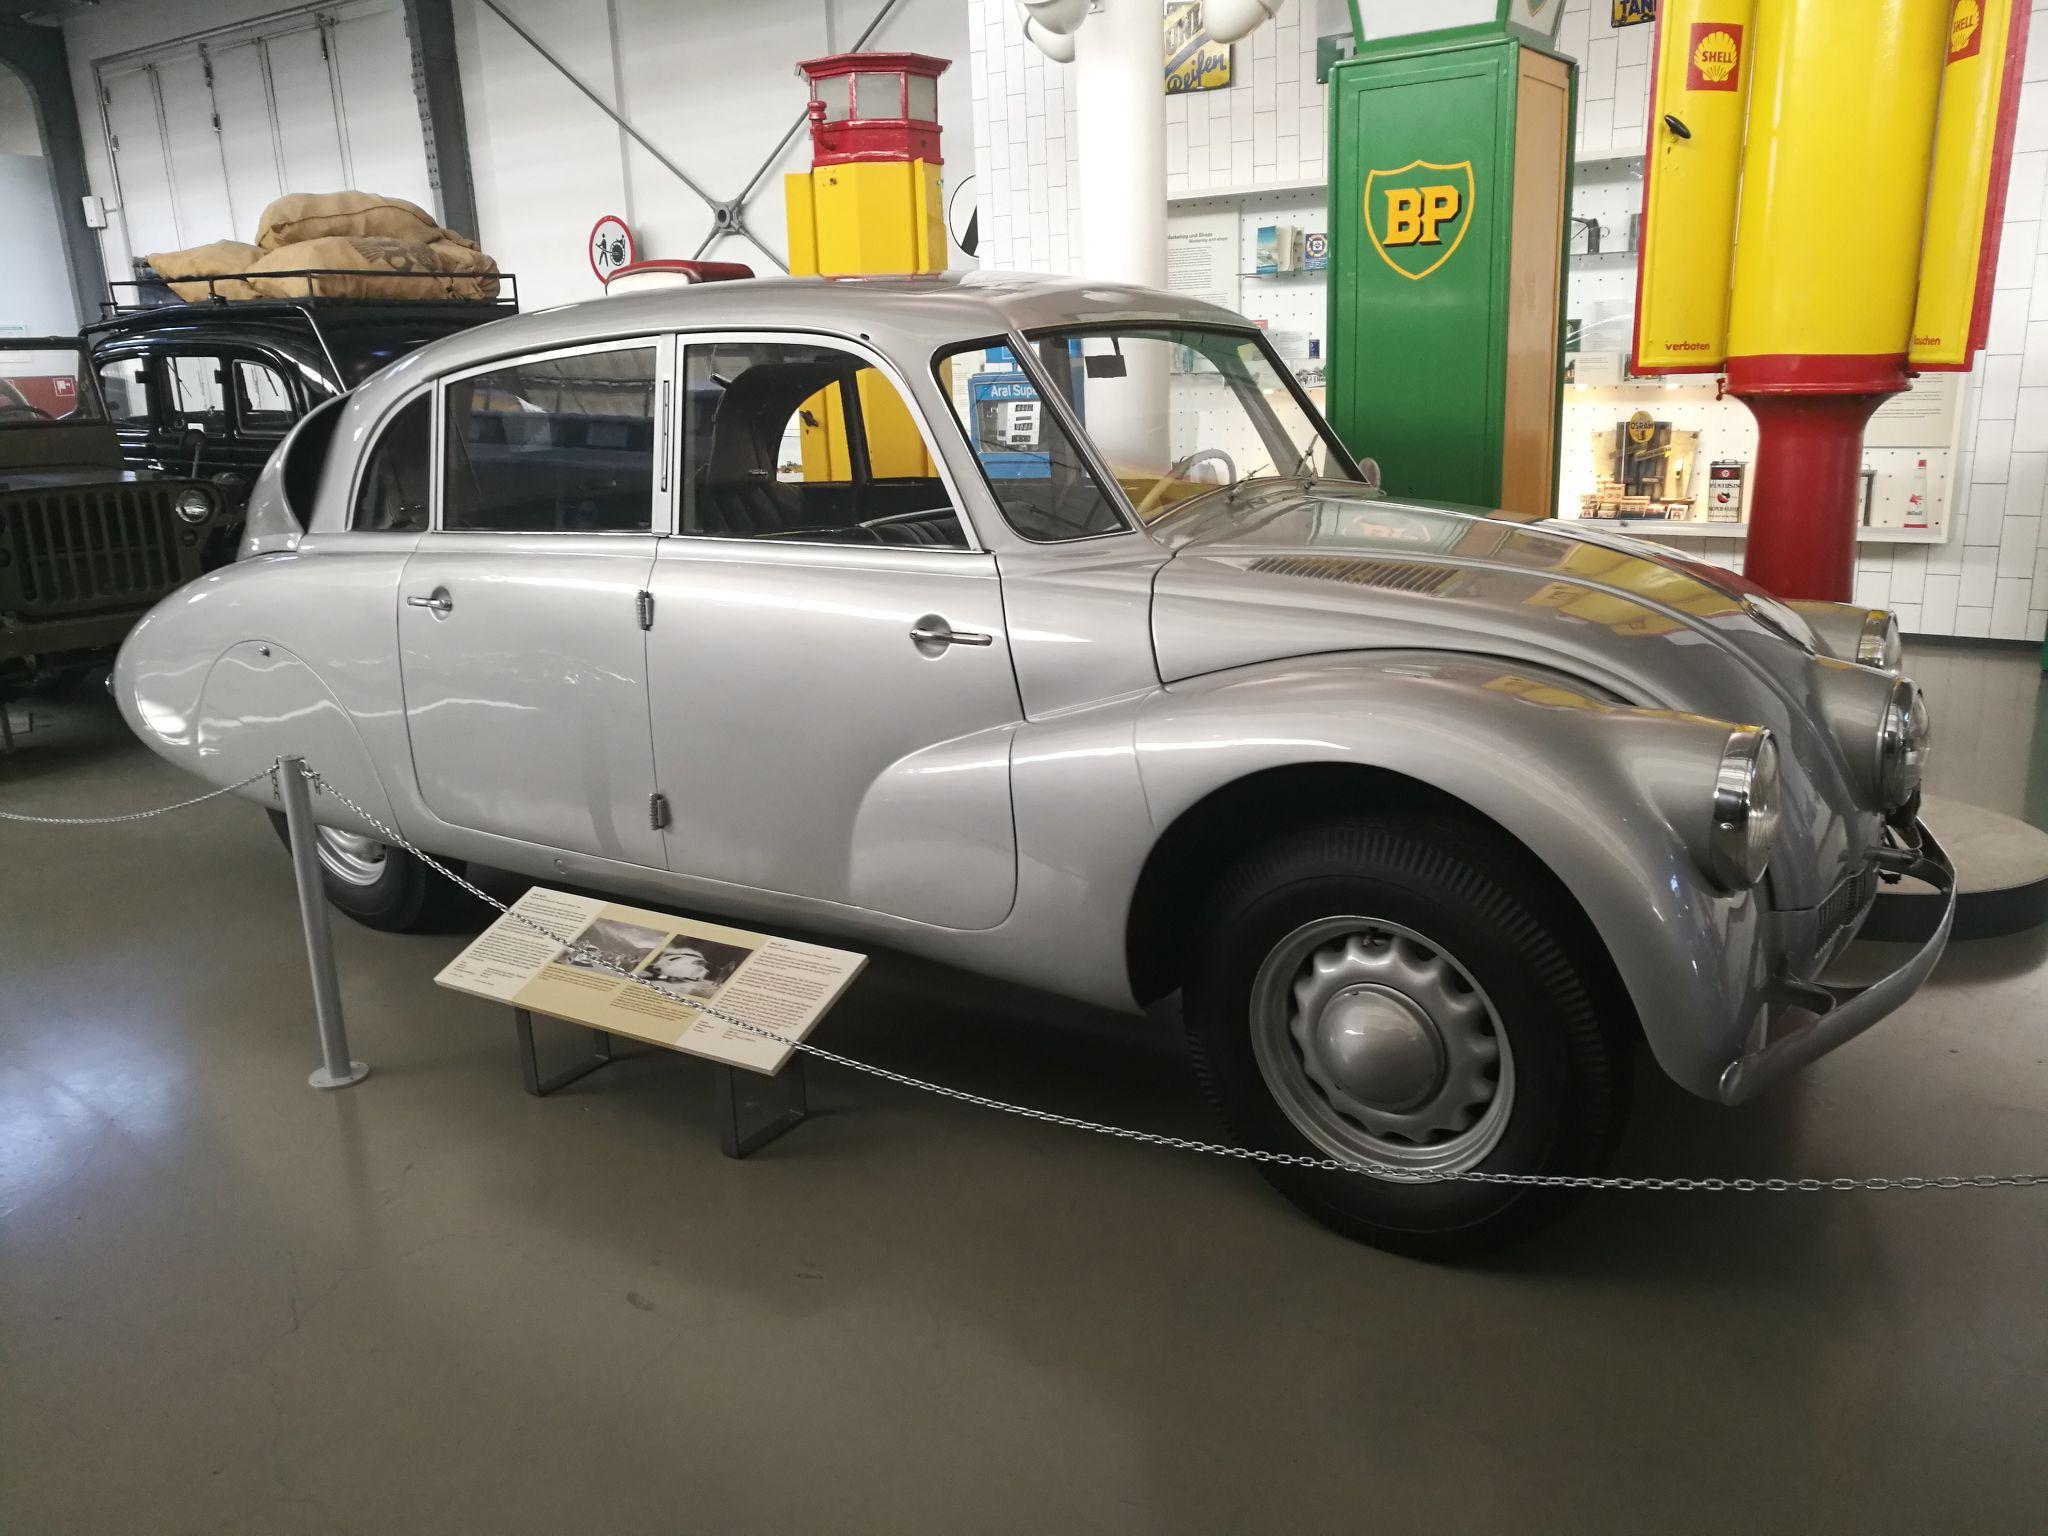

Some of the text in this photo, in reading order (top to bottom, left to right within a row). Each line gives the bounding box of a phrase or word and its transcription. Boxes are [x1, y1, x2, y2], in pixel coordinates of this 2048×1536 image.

[1953, 15, 1973, 33] SHELL
[1702, 51, 1732, 63] SHELL
[1167, 49, 1227, 92] Reifen
[1383, 185, 1462, 247] BP
[1665, 340, 1710, 351] verboten
[991, 385, 1011, 397] Aral
[1630, 422, 1653, 430] OSRAM
